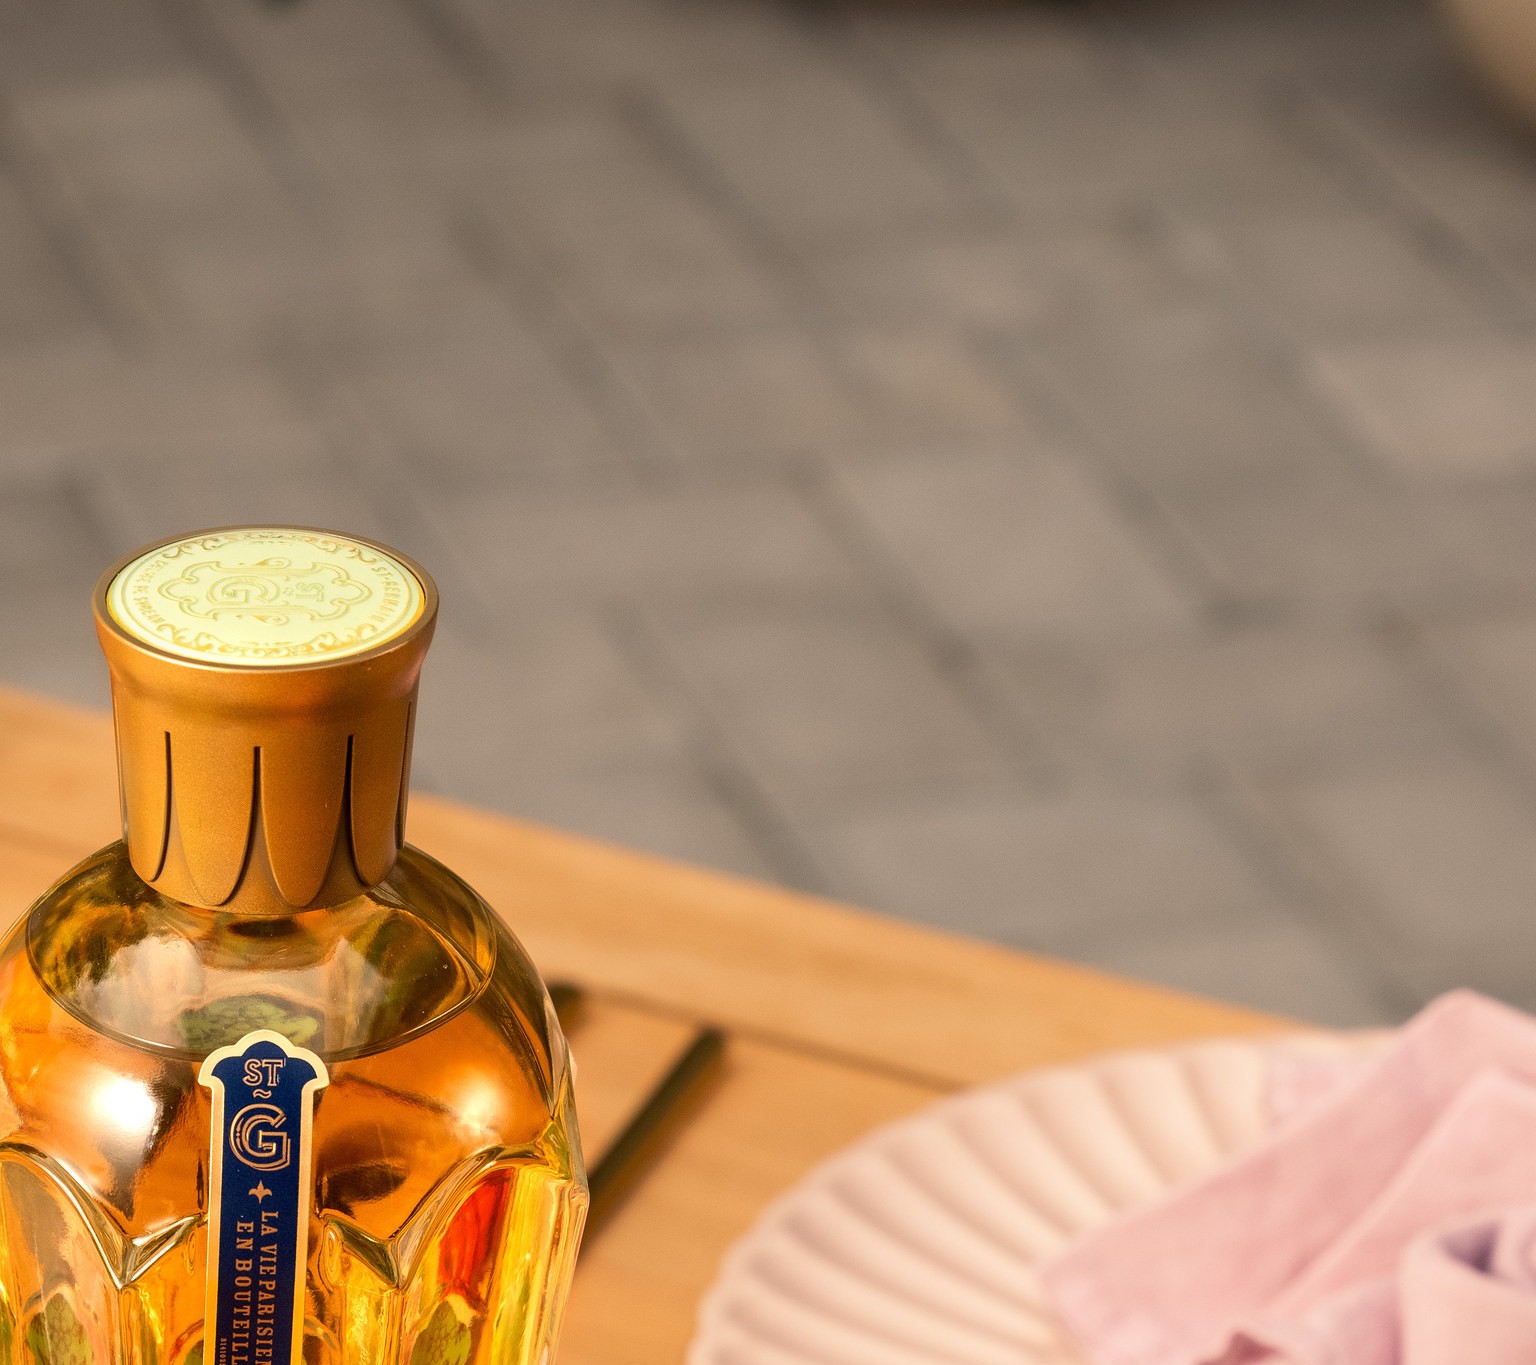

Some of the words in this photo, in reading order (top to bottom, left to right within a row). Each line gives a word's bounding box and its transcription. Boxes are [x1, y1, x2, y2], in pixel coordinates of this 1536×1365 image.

[242, 1058, 286, 1087] ST
[230, 1103, 291, 1172] G
[236, 1220, 255, 1251] EN
[260, 1210, 279, 1236] LA
[259, 1244, 278, 1276] VIE
